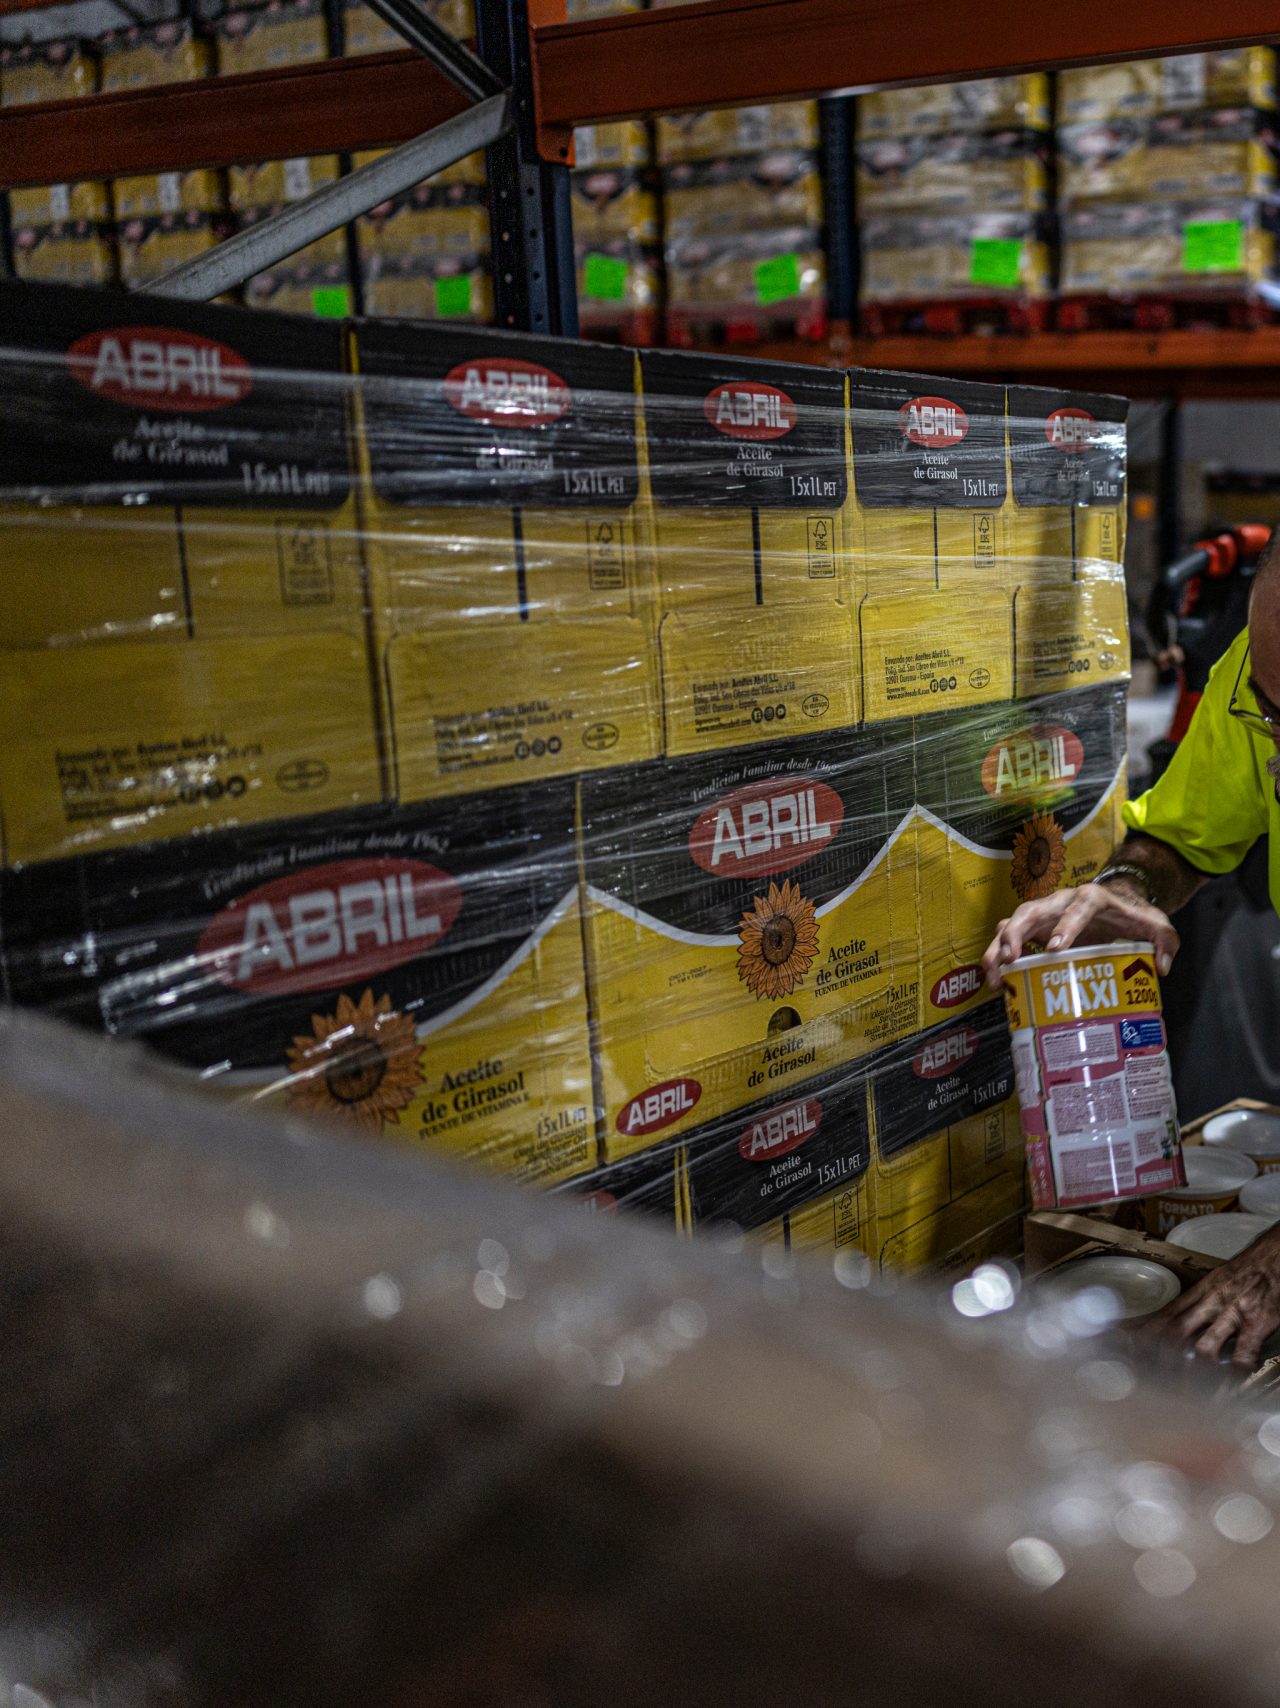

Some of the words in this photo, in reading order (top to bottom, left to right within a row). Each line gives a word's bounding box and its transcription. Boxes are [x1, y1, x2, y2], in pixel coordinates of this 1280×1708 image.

[90, 336, 240, 398] ABRIL
[716, 390, 790, 428] ABRIL
[906, 405, 963, 438] ABRIL
[737, 446, 773, 460] Aceite
[921, 453, 949, 466] Aceite
[562, 470, 606, 493] 15x1L
[726, 462, 740, 476] de
[743, 462, 784, 477] Girasol
[913, 466, 926, 479] de
[926, 467, 958, 480] Girasol
[790, 476, 822, 496] 15x1L
[823, 481, 837, 496] PET
[963, 478, 987, 497] 15x1L
[988, 482, 999, 497] PET
[742, 759, 785, 779] Familiar
[786, 757, 812, 771] desde
[995, 735, 1076, 794] ABRIL
[710, 789, 832, 866] ABRIL
[1072, 861, 1098, 879] Aceite
[235, 872, 442, 981] ABRIL
[827, 938, 866, 963] Aceite
[816, 969, 832, 986] de
[834, 949, 880, 979] Girasol
[1041, 962, 1115, 987] FORMATO
[814, 982, 839, 998] FUENTE
[840, 978, 849, 988] DE
[849, 969, 878, 984] VITAMINA
[937, 968, 981, 1004] ABRIL
[1044, 978, 1119, 1018] MAXI
[761, 1037, 804, 1065] Aceite
[921, 1031, 974, 1074] ABRIL
[440, 1059, 503, 1094] Aceite
[747, 1070, 765, 1088] de
[768, 1046, 816, 1080] Girasol
[422, 1101, 448, 1124] de
[453, 1071, 525, 1113] Girasol
[927, 1097, 938, 1111] de
[939, 1083, 969, 1106] Girasol
[935, 1075, 961, 1095] Aceite
[973, 1081, 996, 1106] 15x1L
[626, 1083, 694, 1131] ABRIL
[750, 1102, 817, 1156] ABRIL
[759, 1183, 773, 1197] de
[775, 1162, 812, 1189] Girasol
[769, 1155, 801, 1178] Aceite
[817, 1156, 848, 1185] 15x1L
[848, 1152, 861, 1170] PET
